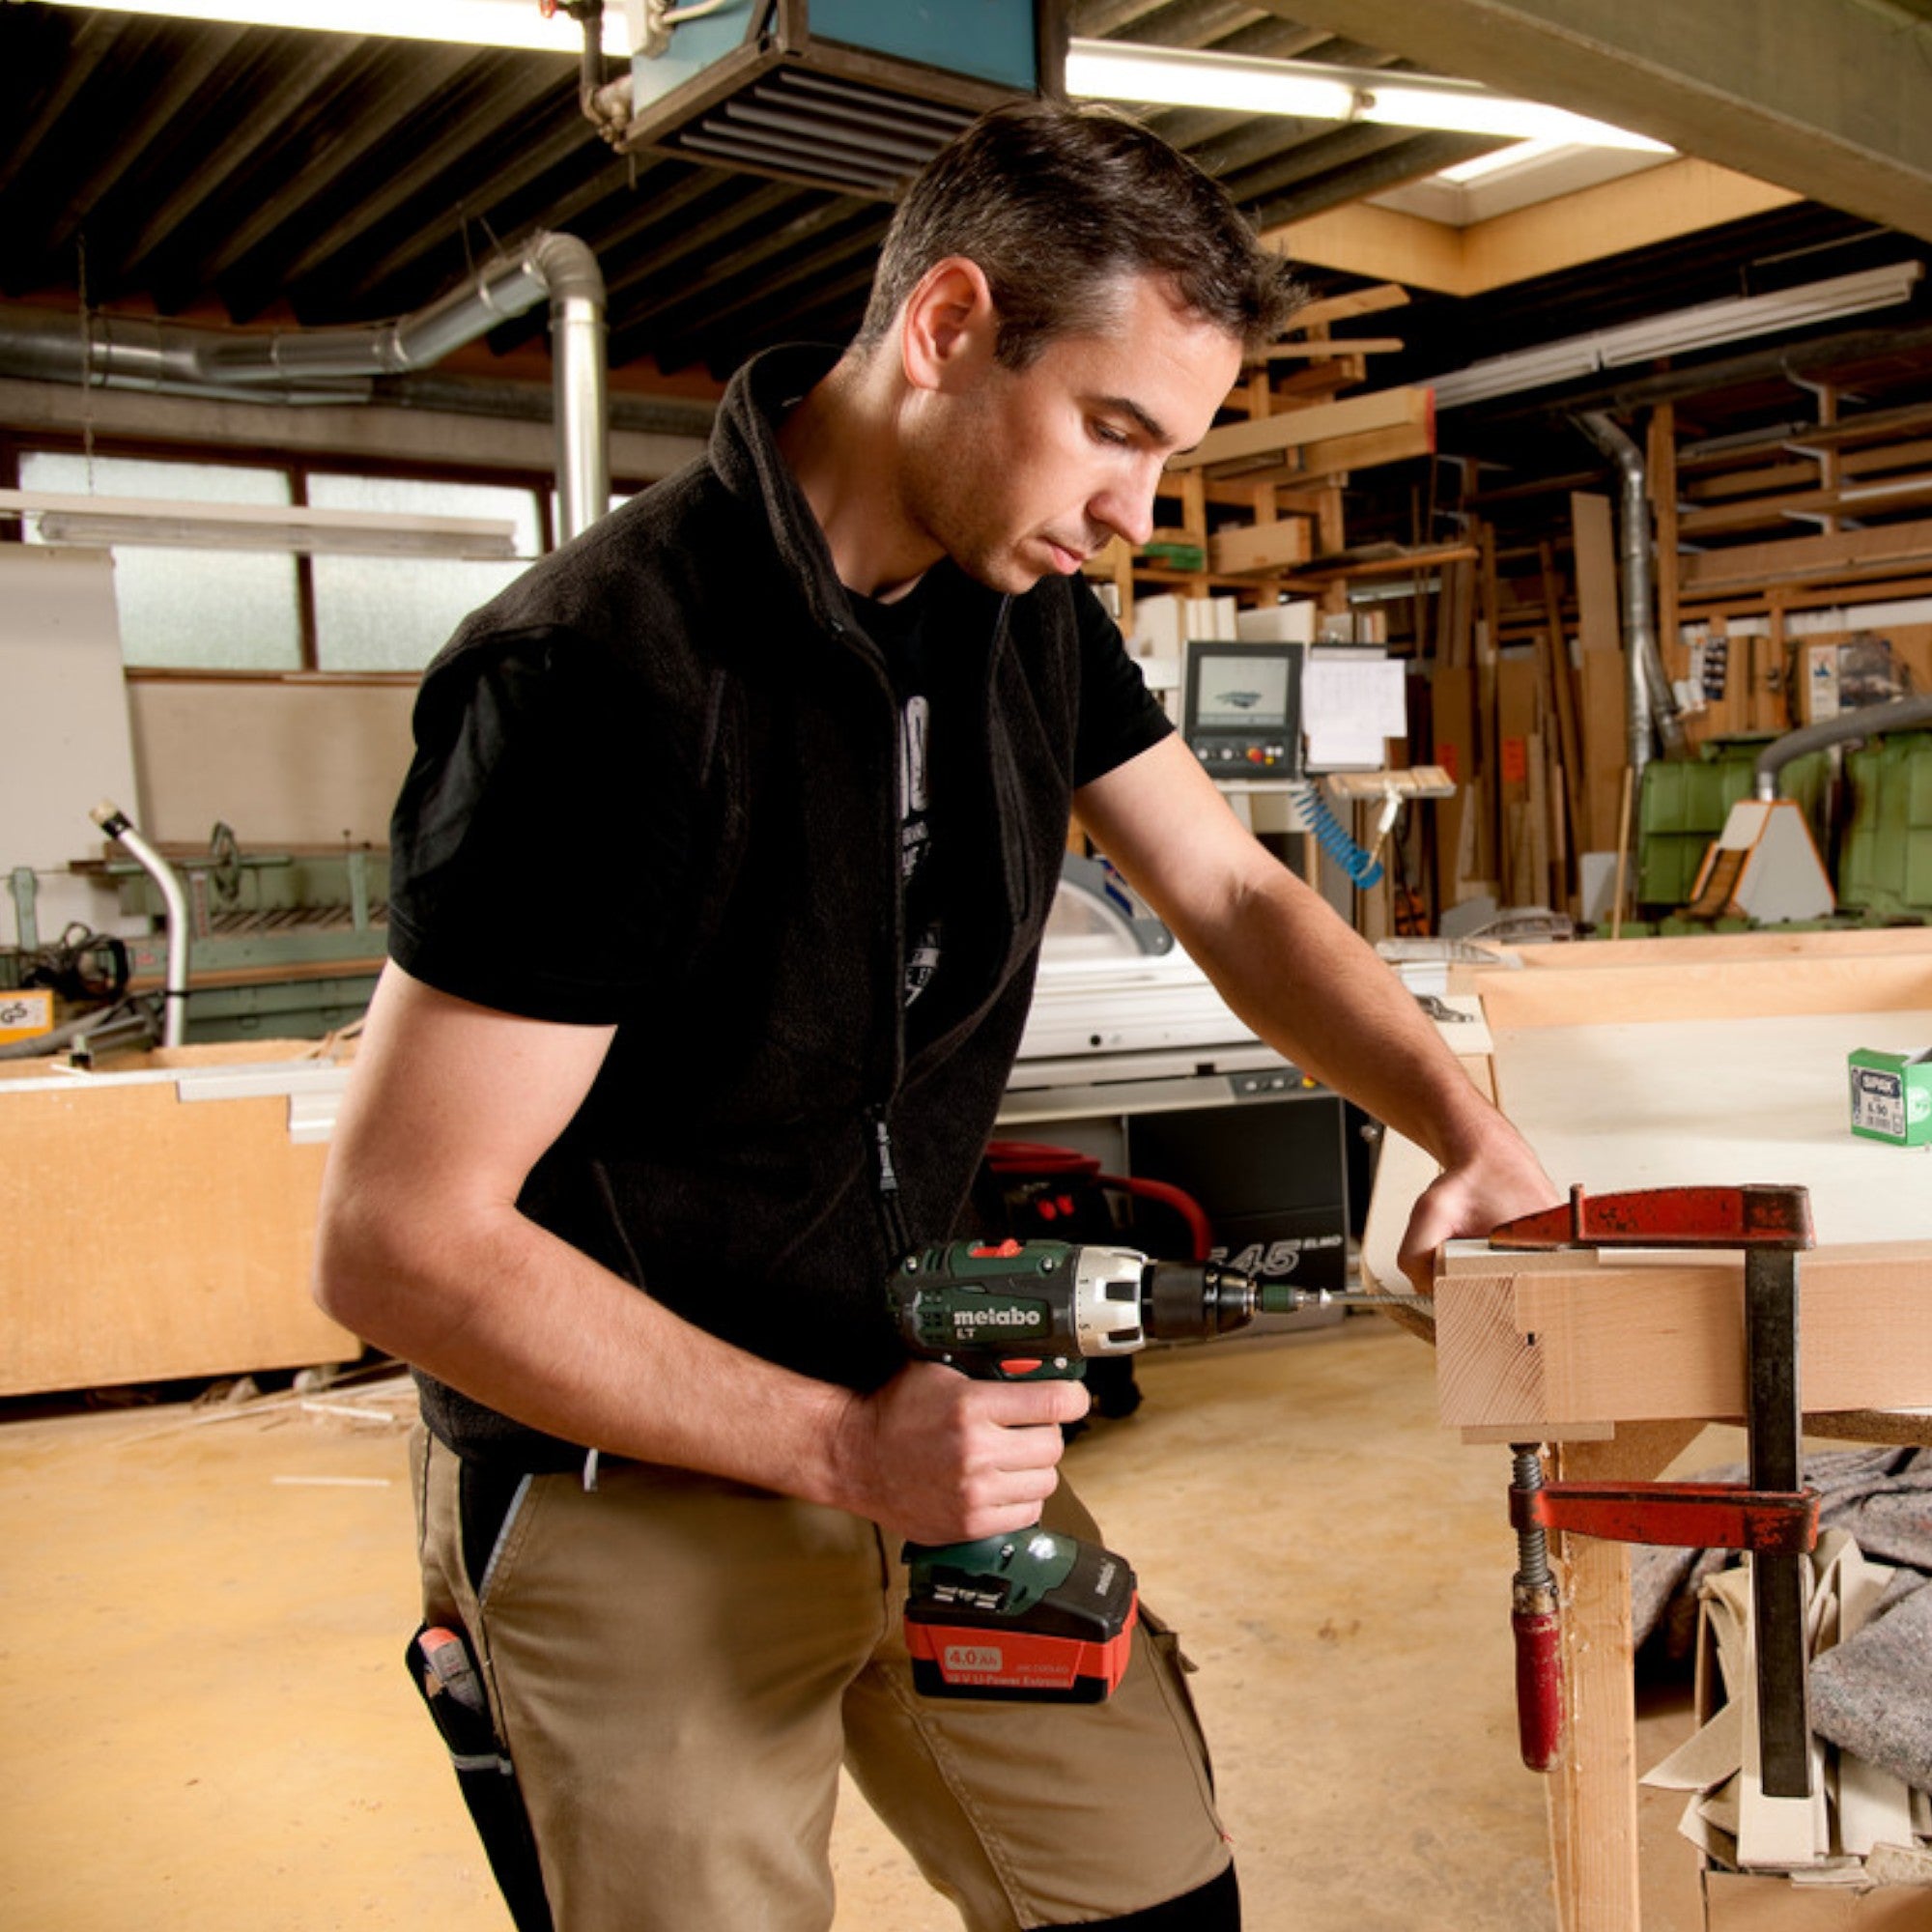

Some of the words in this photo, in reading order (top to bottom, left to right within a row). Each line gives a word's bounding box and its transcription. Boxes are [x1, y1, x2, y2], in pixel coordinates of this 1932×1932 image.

[953, 1306, 1041, 1325] metabo
[955, 1327, 975, 1341] LT
[950, 1649, 978, 1665] 4.0
